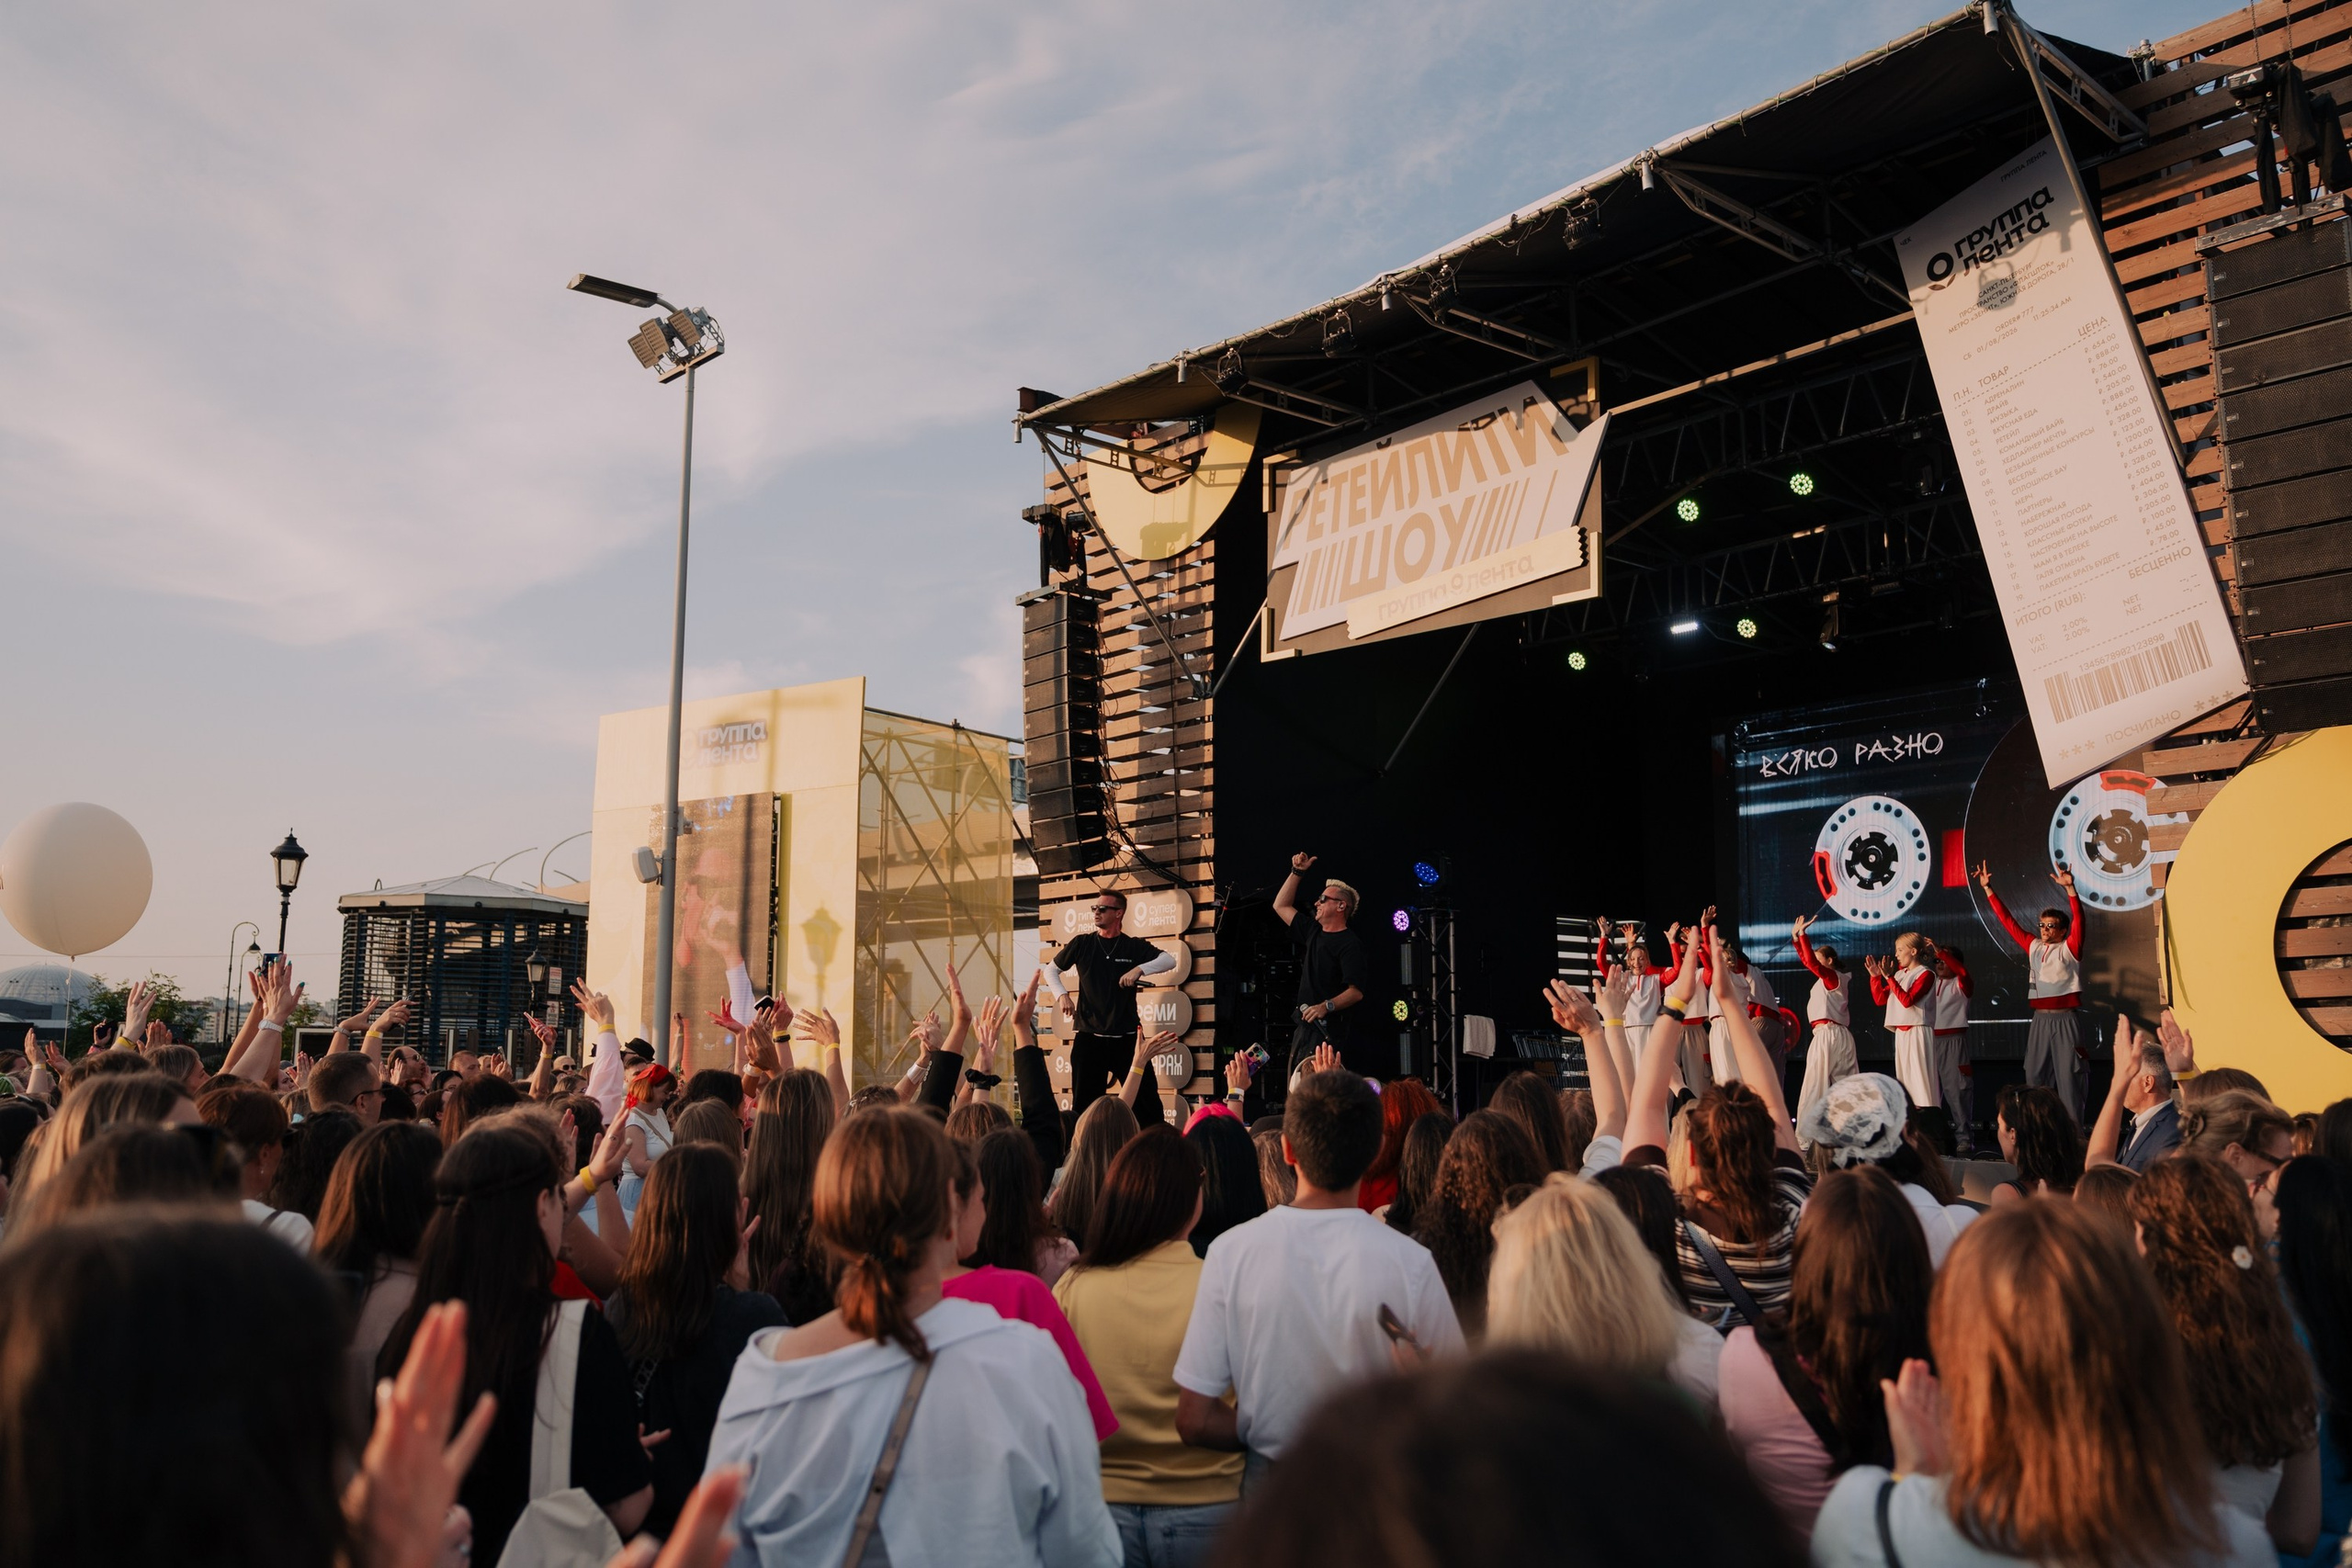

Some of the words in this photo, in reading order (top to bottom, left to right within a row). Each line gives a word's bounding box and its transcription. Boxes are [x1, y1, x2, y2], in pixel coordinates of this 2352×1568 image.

[2000, 163, 2026, 184] ГРУППА
[2025, 149, 2047, 167] ЛЕНТА
[1954, 186, 2054, 259] группа
[1963, 211, 2051, 276] лента
[1948, 318, 1970, 335] МЕТРО
[1999, 285, 2027, 305] ЮЖНАЯ
[2026, 267, 2057, 289] ДОРОГА,
[1959, 286, 2008, 320] ПРОСТРАНСТВО
[1978, 262, 2033, 299] САНКТ-ПЕТЕРБУРГ
[2021, 306, 2035, 318] 777
[1953, 385, 1973, 402] П.Н.
[1977, 365, 2010, 389] ТОВАР
[2077, 314, 2109, 338] ЦЕНА
[1976, 326, 2018, 355] 01/08/2026
[2033, 303, 2059, 322] 11:25:34
[1984, 378, 2025, 406] АДРЕНАЛИН
[2091, 333, 2117, 350] 654.00
[1985, 398, 2009, 416] ДРАЙВ
[2095, 343, 2120, 360] 888.00
[1989, 405, 2018, 425] МУЗЫКА
[2098, 355, 2119, 371] 76.00
[1993, 415, 2023, 435] ВКУСНАЯ
[2023, 407, 2039, 420] ЕДА
[2102, 363, 2128, 381] 540.00
[1996, 427, 2020, 446] РЕТЕЙЛ
[2106, 374, 2132, 392] 205.00
[1998, 426, 2045, 456] КОМАНДНЫЙ
[2045, 416, 2064, 432] ВАЙБ
[2109, 384, 2135, 402] 888.00
[2001, 439, 2042, 466] ХЕДЛАЙНЕР
[2042, 428, 2067, 446] МЕЧТЫ
[2113, 395, 2139, 412] 456.00
[2005, 446, 2055, 476] БЕЗБАШЕННЫЕ
[2055, 426, 2095, 451] КОНКУРСЫ
[2117, 406, 2142, 423] 328.00
[2007, 467, 2037, 486] ВЕСЕЛЬЕ
[2121, 417, 2145, 434] 123.00
[2011, 470, 2054, 497] СПЛОШНОЕ
[2054, 464, 2068, 476] ВАУ
[2125, 425, 2154, 444] 1200.00
[2014, 493, 2033, 507] МЕРЧ
[2127, 437, 2154, 455] 654.00
[2018, 495, 2053, 517] ПАРТНЕРЫ
[2132, 449, 2157, 466] 328.00
[2020, 501, 2067, 527] НАБЕРЕЖНАЯ
[2135, 459, 2162, 477] 505.00
[2023, 516, 2061, 538] ХОРОШАЯ
[2061, 502, 2093, 522] ПОГОДА
[2139, 470, 2165, 488] 404.00
[2027, 526, 2066, 549] КЛАССНЫЕ
[2065, 513, 2093, 531] ФОТКИ
[2143, 481, 2170, 499] 306.00
[1338, 494, 1478, 604] ШОУ
[2030, 534, 2077, 560] НАСТРОЕНИЕ
[2076, 528, 2089, 538] НА
[2088, 514, 2119, 533] ВЫСОТЕ
[2033, 558, 2052, 570] МАМ
[2052, 554, 2058, 562] Я
[2064, 540, 2090, 557] ТЕЛЕКЕ
[2151, 504, 2177, 521] 100.00
[2036, 568, 2054, 581] ГАЛЯ
[2054, 554, 2086, 573] ОТМЕНА
[2154, 517, 2177, 533] 45.00
[2039, 573, 2072, 592] ПАКЕТИК
[2073, 563, 2094, 578] БРАТЬ
[2094, 551, 2120, 569] БУДЕТЕ
[2157, 529, 2180, 544] 78.00
[1378, 582, 1447, 622] группа
[1463, 553, 1534, 594] лента
[2015, 604, 2052, 627] ИТОГО
[2053, 590, 2087, 613] (RUB):
[2128, 545, 2193, 581] БЕСЦЕННО
[2028, 633, 2045, 646] VAT:
[2062, 615, 2088, 632] 2.00%
[2030, 642, 2048, 655] VAT:
[2064, 625, 2091, 642] 2.00%
[2078, 632, 2165, 673] 1345678902123890
[698, 721, 767, 747] группа
[698, 742, 758, 768] лента
[1759, 747, 1838, 778] ВСЯКО
[1855, 732, 1944, 764] РАЗНО
[2105, 709, 2183, 745] ПОСЧИТАНО
[1148, 915, 1177, 927] лента
[1149, 903, 1177, 915] супер
